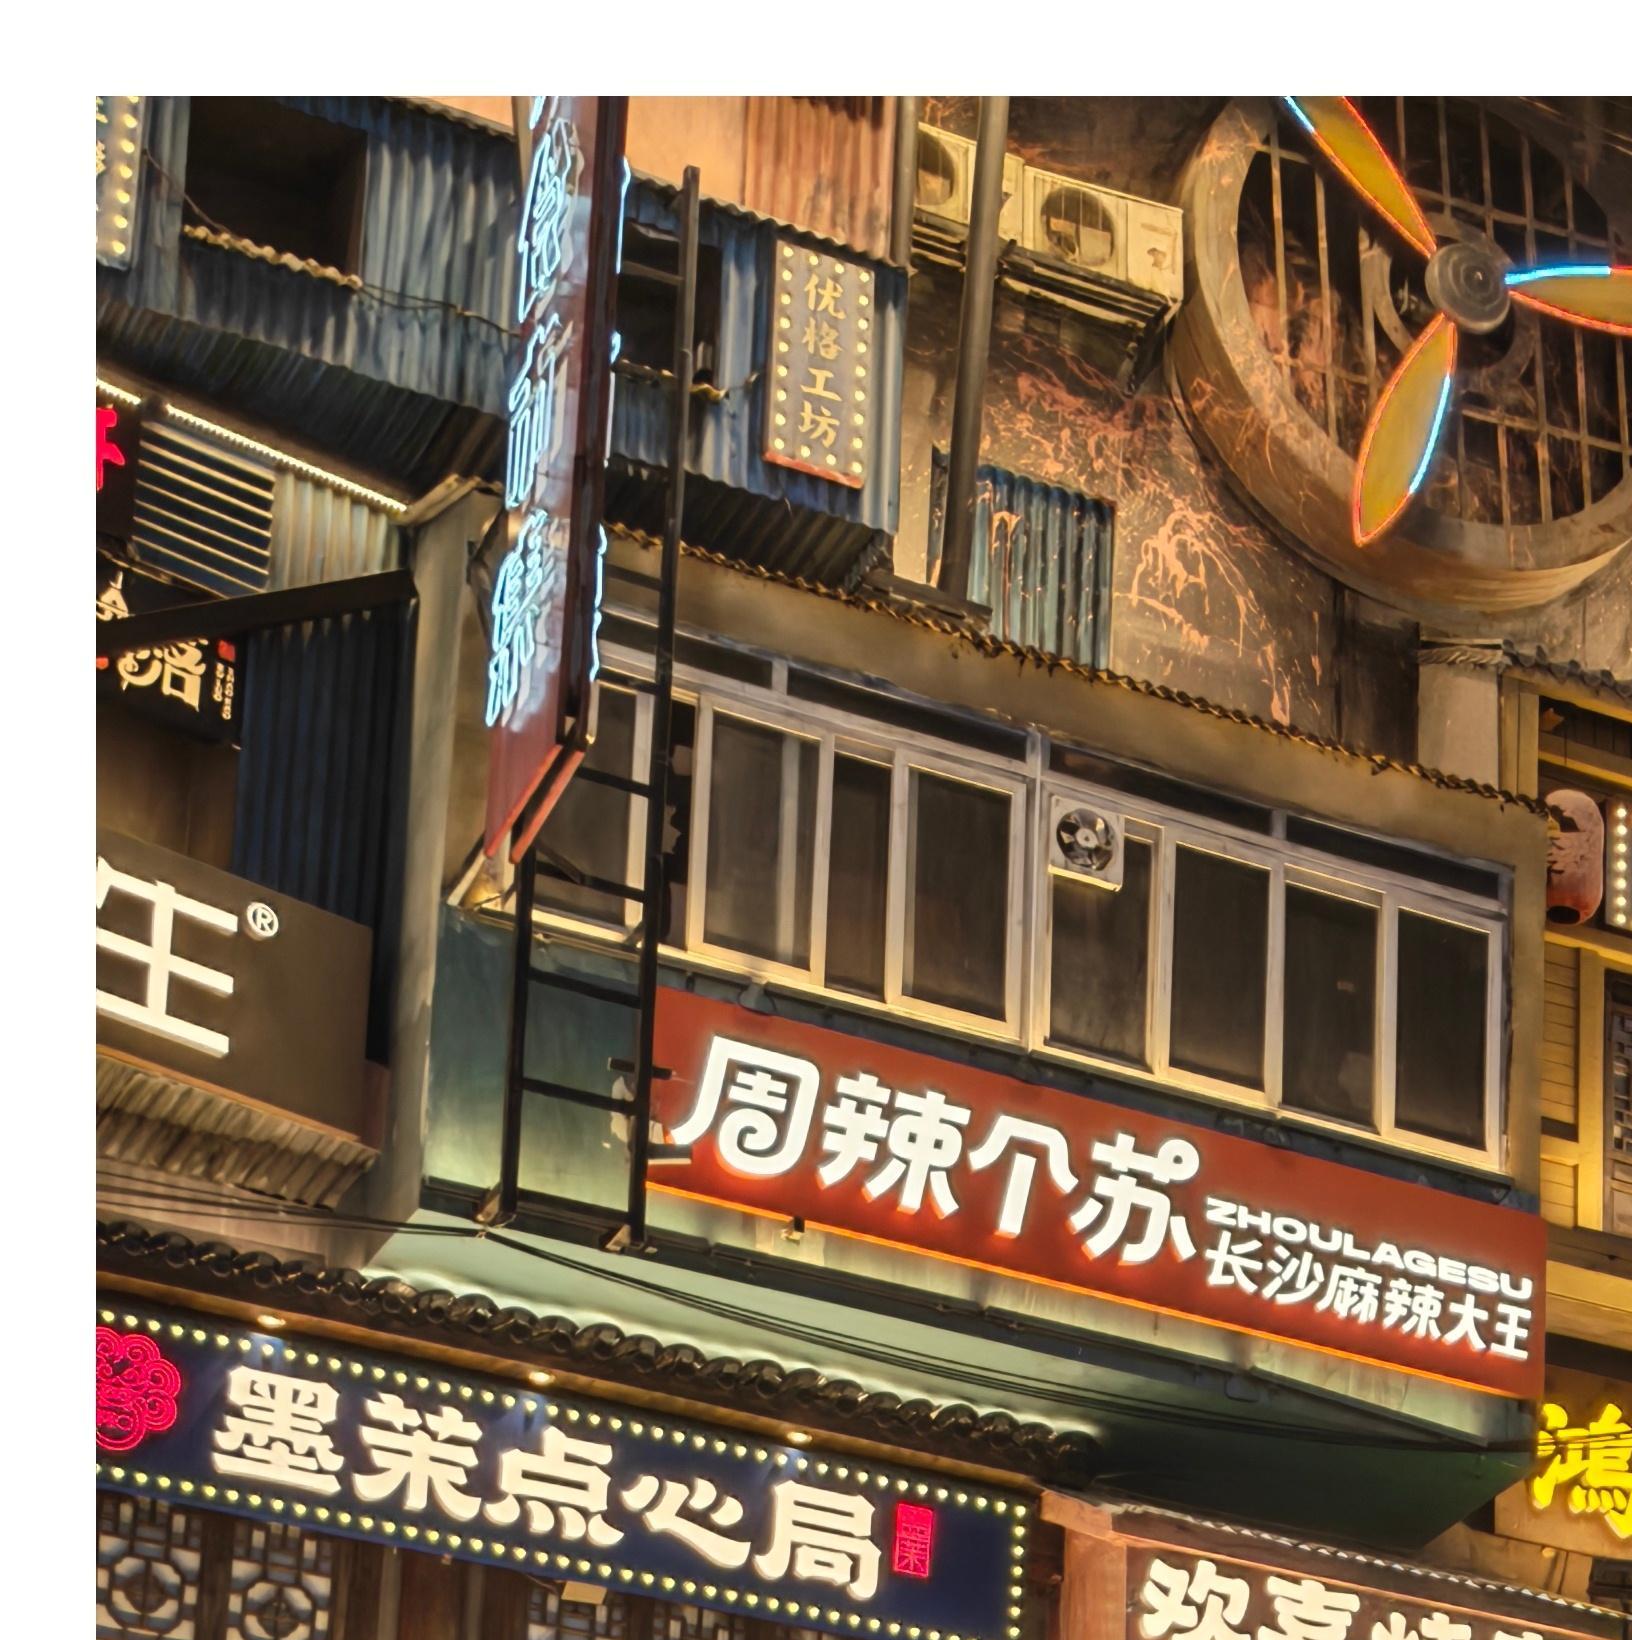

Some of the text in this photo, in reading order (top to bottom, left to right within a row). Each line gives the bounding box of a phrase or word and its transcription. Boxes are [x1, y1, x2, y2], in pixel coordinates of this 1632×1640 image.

[666, 1034, 1201, 1266] 周辣个苏
[1204, 1230, 1533, 1362] 长沙麻辣大王
[1205, 1194, 1534, 1301] ZHOULAGESU
[211, 1363, 884, 1600] 墨茉点心局
